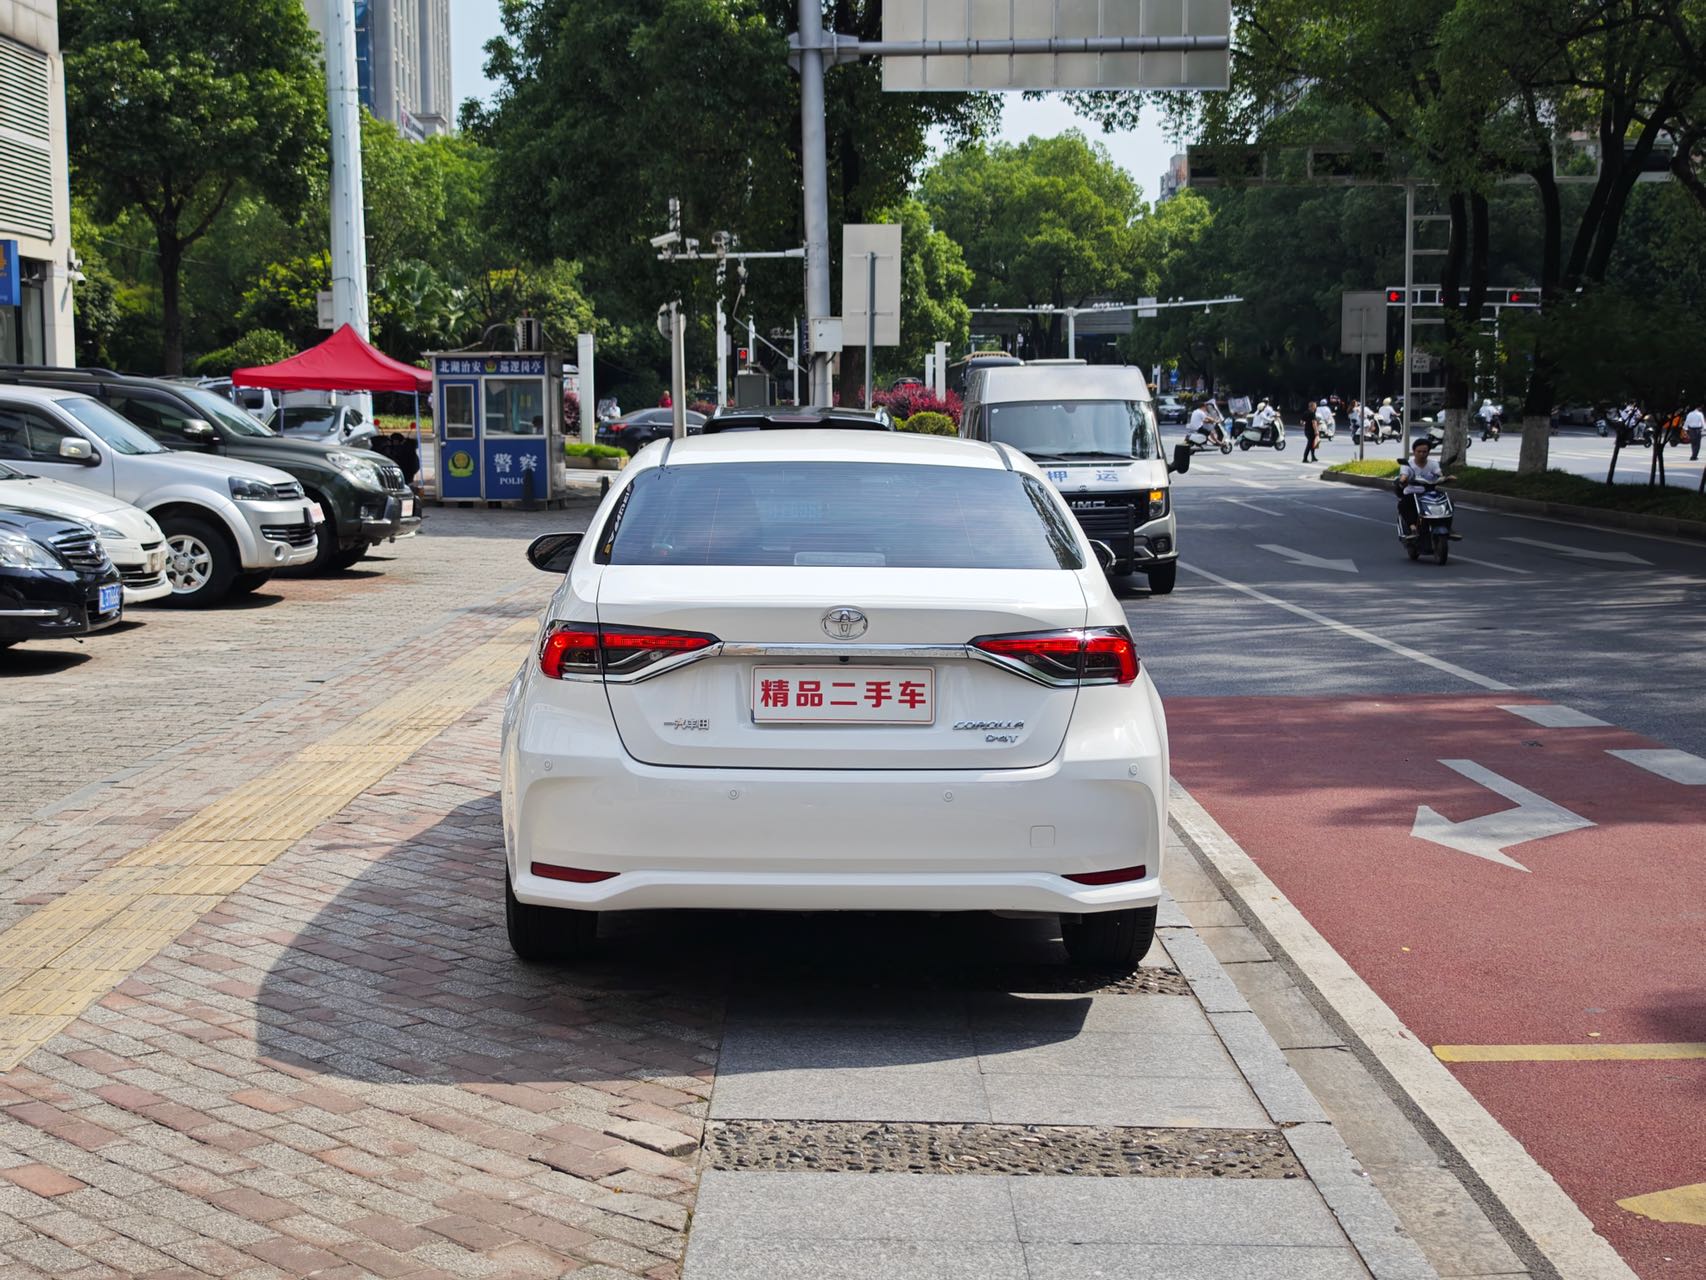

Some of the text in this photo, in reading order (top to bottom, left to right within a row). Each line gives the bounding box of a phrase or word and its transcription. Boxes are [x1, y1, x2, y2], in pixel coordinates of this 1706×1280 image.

[440, 360, 541, 373] 北湖治安 巡逻岗亭
[494, 453, 538, 473] 警察
[1047, 470, 1119, 482] 押运
[760, 679, 927, 709] 精品二手车
[663, 718, 710, 731] 一汽丰田
[952, 720, 1025, 731] COROLLA
